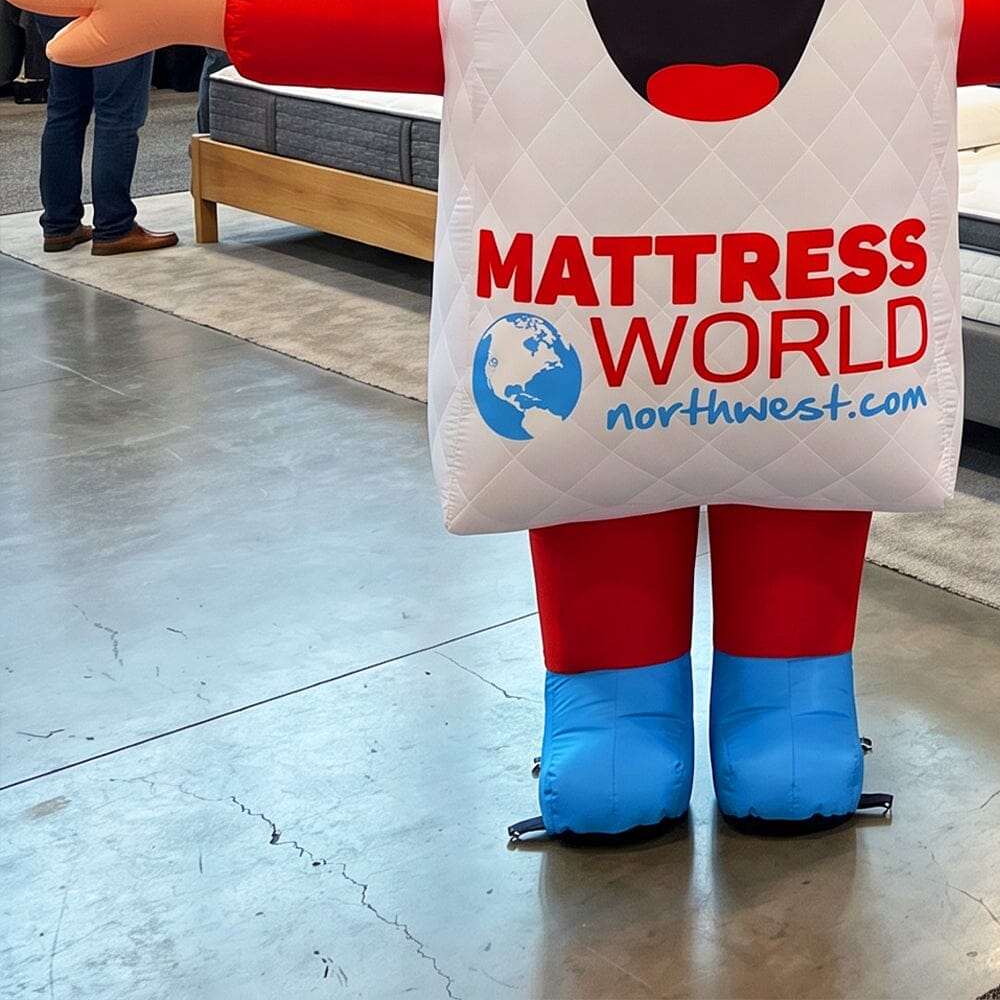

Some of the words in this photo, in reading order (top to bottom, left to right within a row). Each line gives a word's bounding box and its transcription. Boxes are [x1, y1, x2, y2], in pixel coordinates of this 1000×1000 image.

[475, 217, 929, 309] MATTRESS
[588, 294, 929, 389] WORLD
[606, 384, 927, 430] northwest.com
